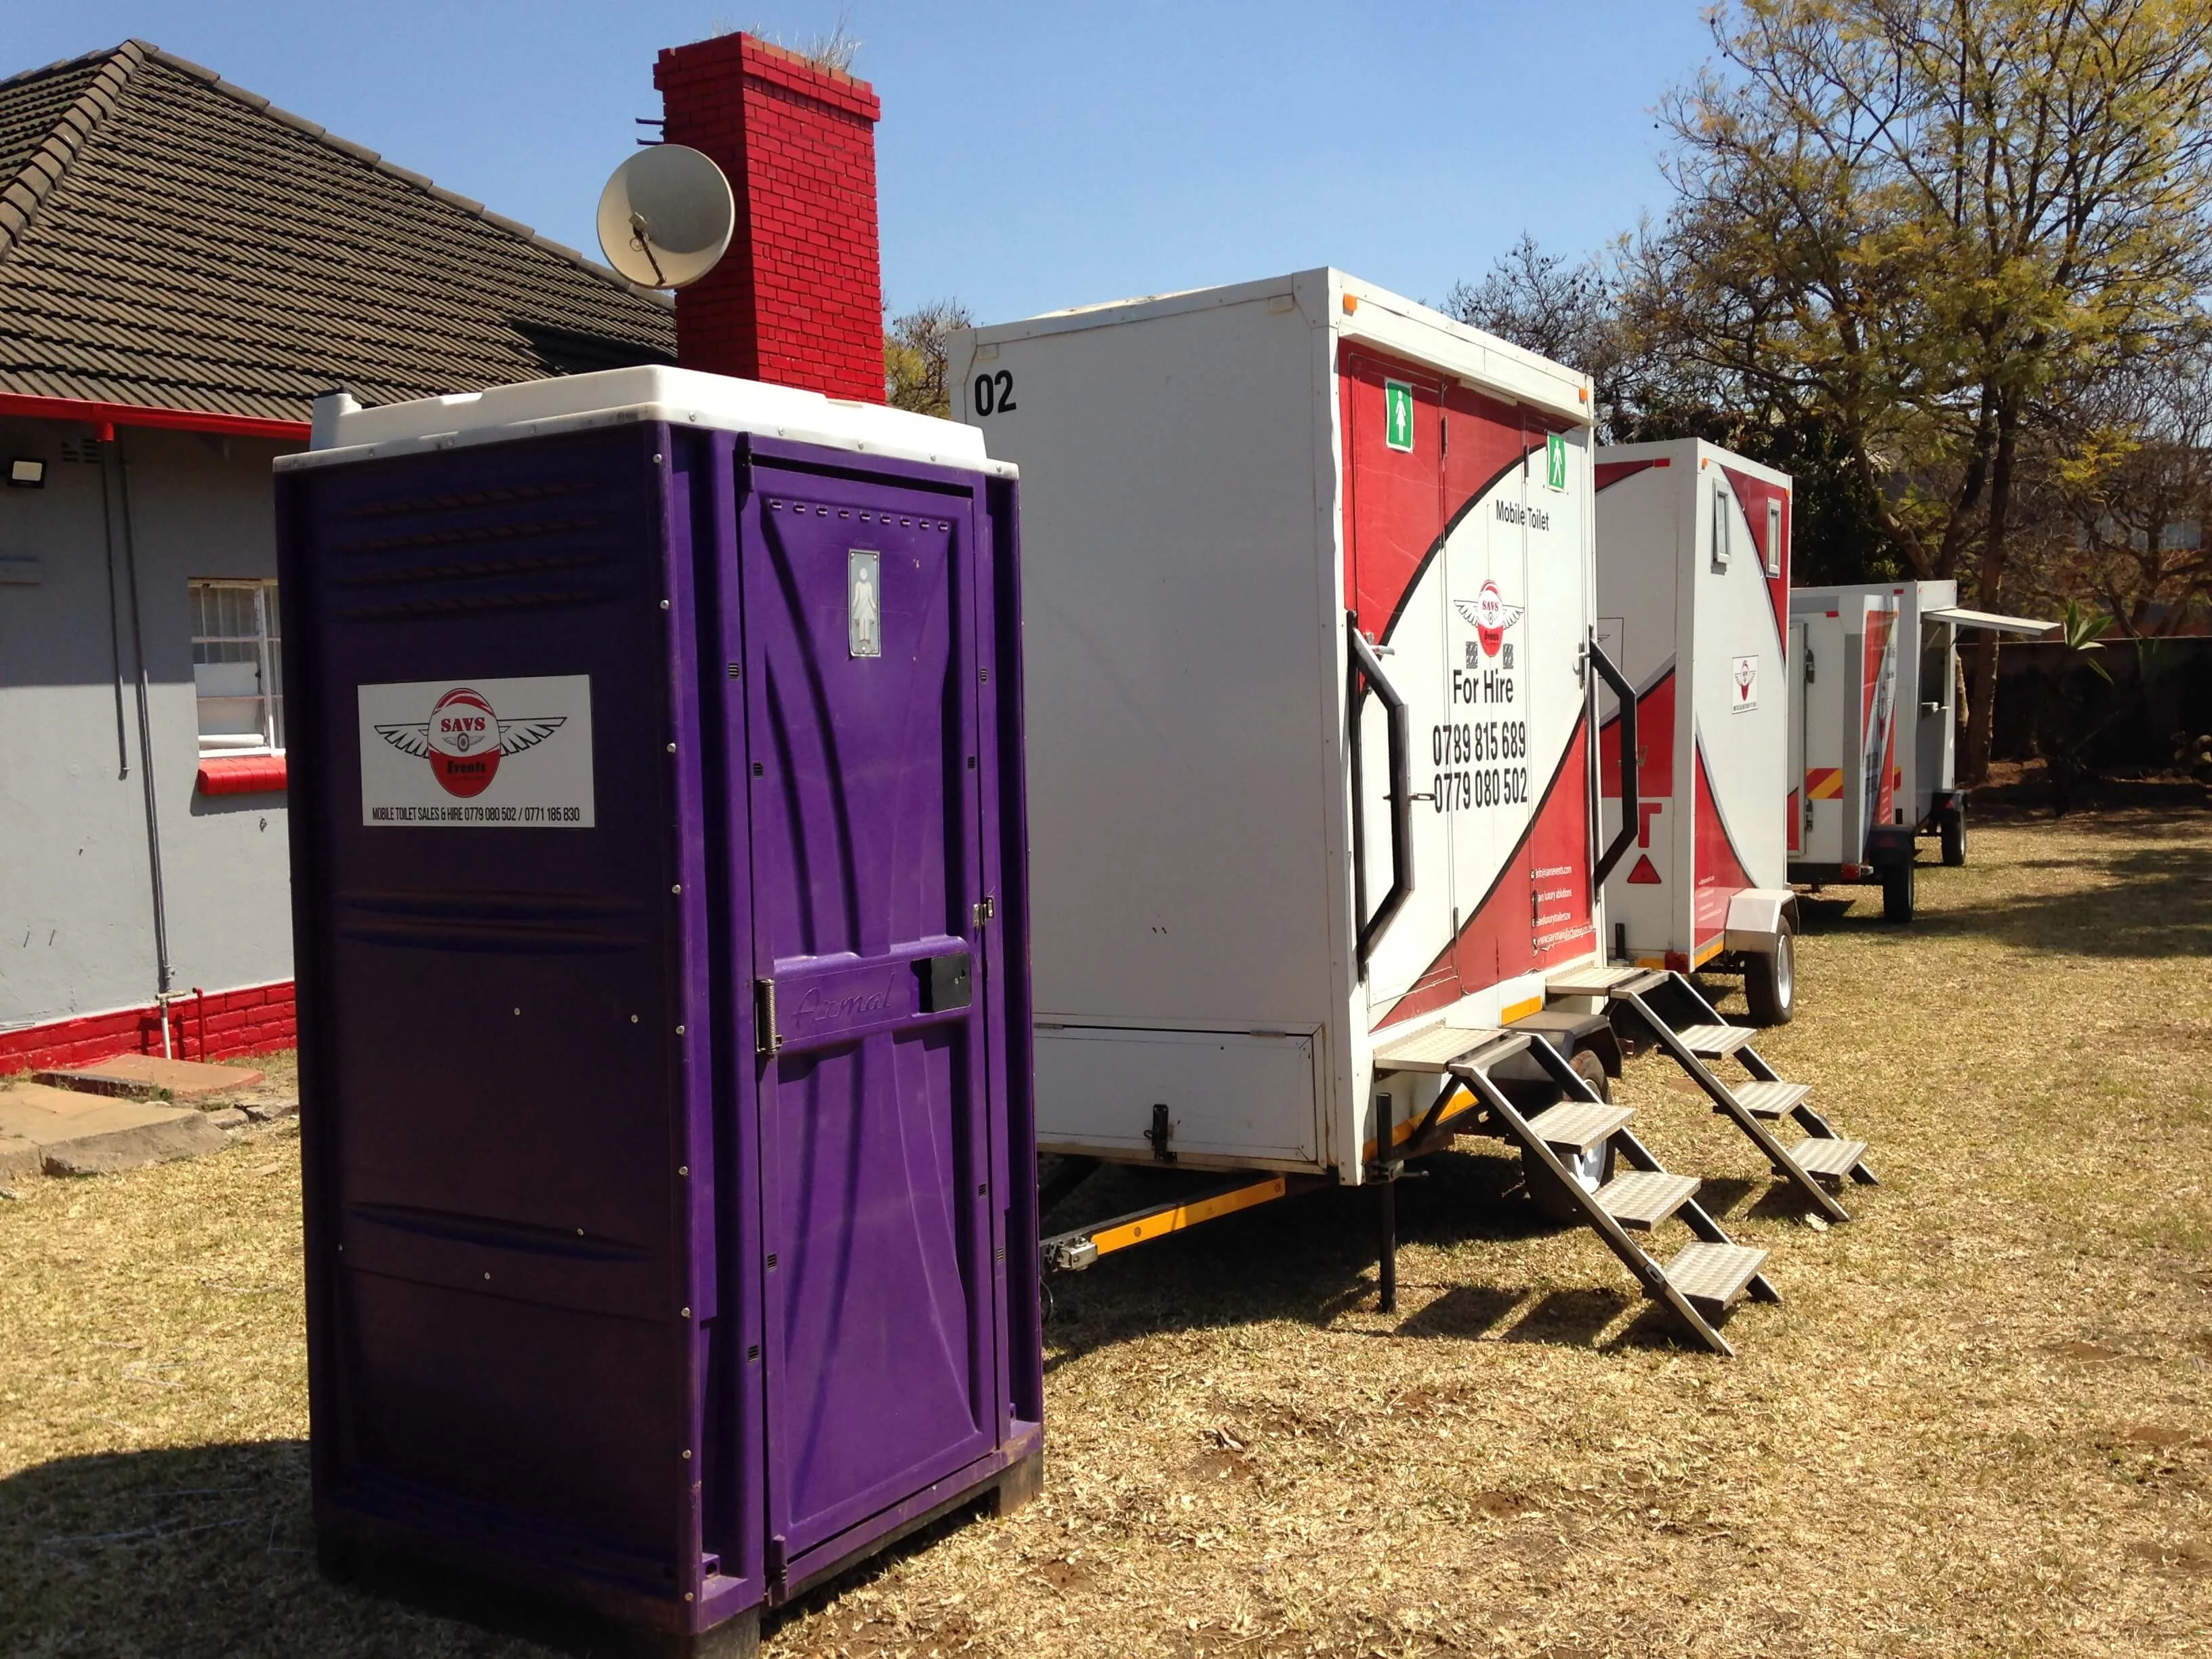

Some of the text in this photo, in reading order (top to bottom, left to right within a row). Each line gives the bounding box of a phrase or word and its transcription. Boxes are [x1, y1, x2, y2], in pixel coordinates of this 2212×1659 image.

[975, 369, 1017, 417] 02
[1496, 499, 1549, 531] Mobile Toilet
[1482, 600, 1499, 611] SAVS
[1453, 668, 1513, 703] For Hire
[441, 716, 486, 732] SAVS
[1433, 721, 1525, 766] 0789 815 689
[447, 760, 487, 775] Events
[1434, 767, 1528, 813] 0779 080 502
[372, 807, 580, 821] MOBILE TOILET SALES & HIRE 0779 080 502 / 0771 185 830
[791, 971, 896, 1029] Armal
